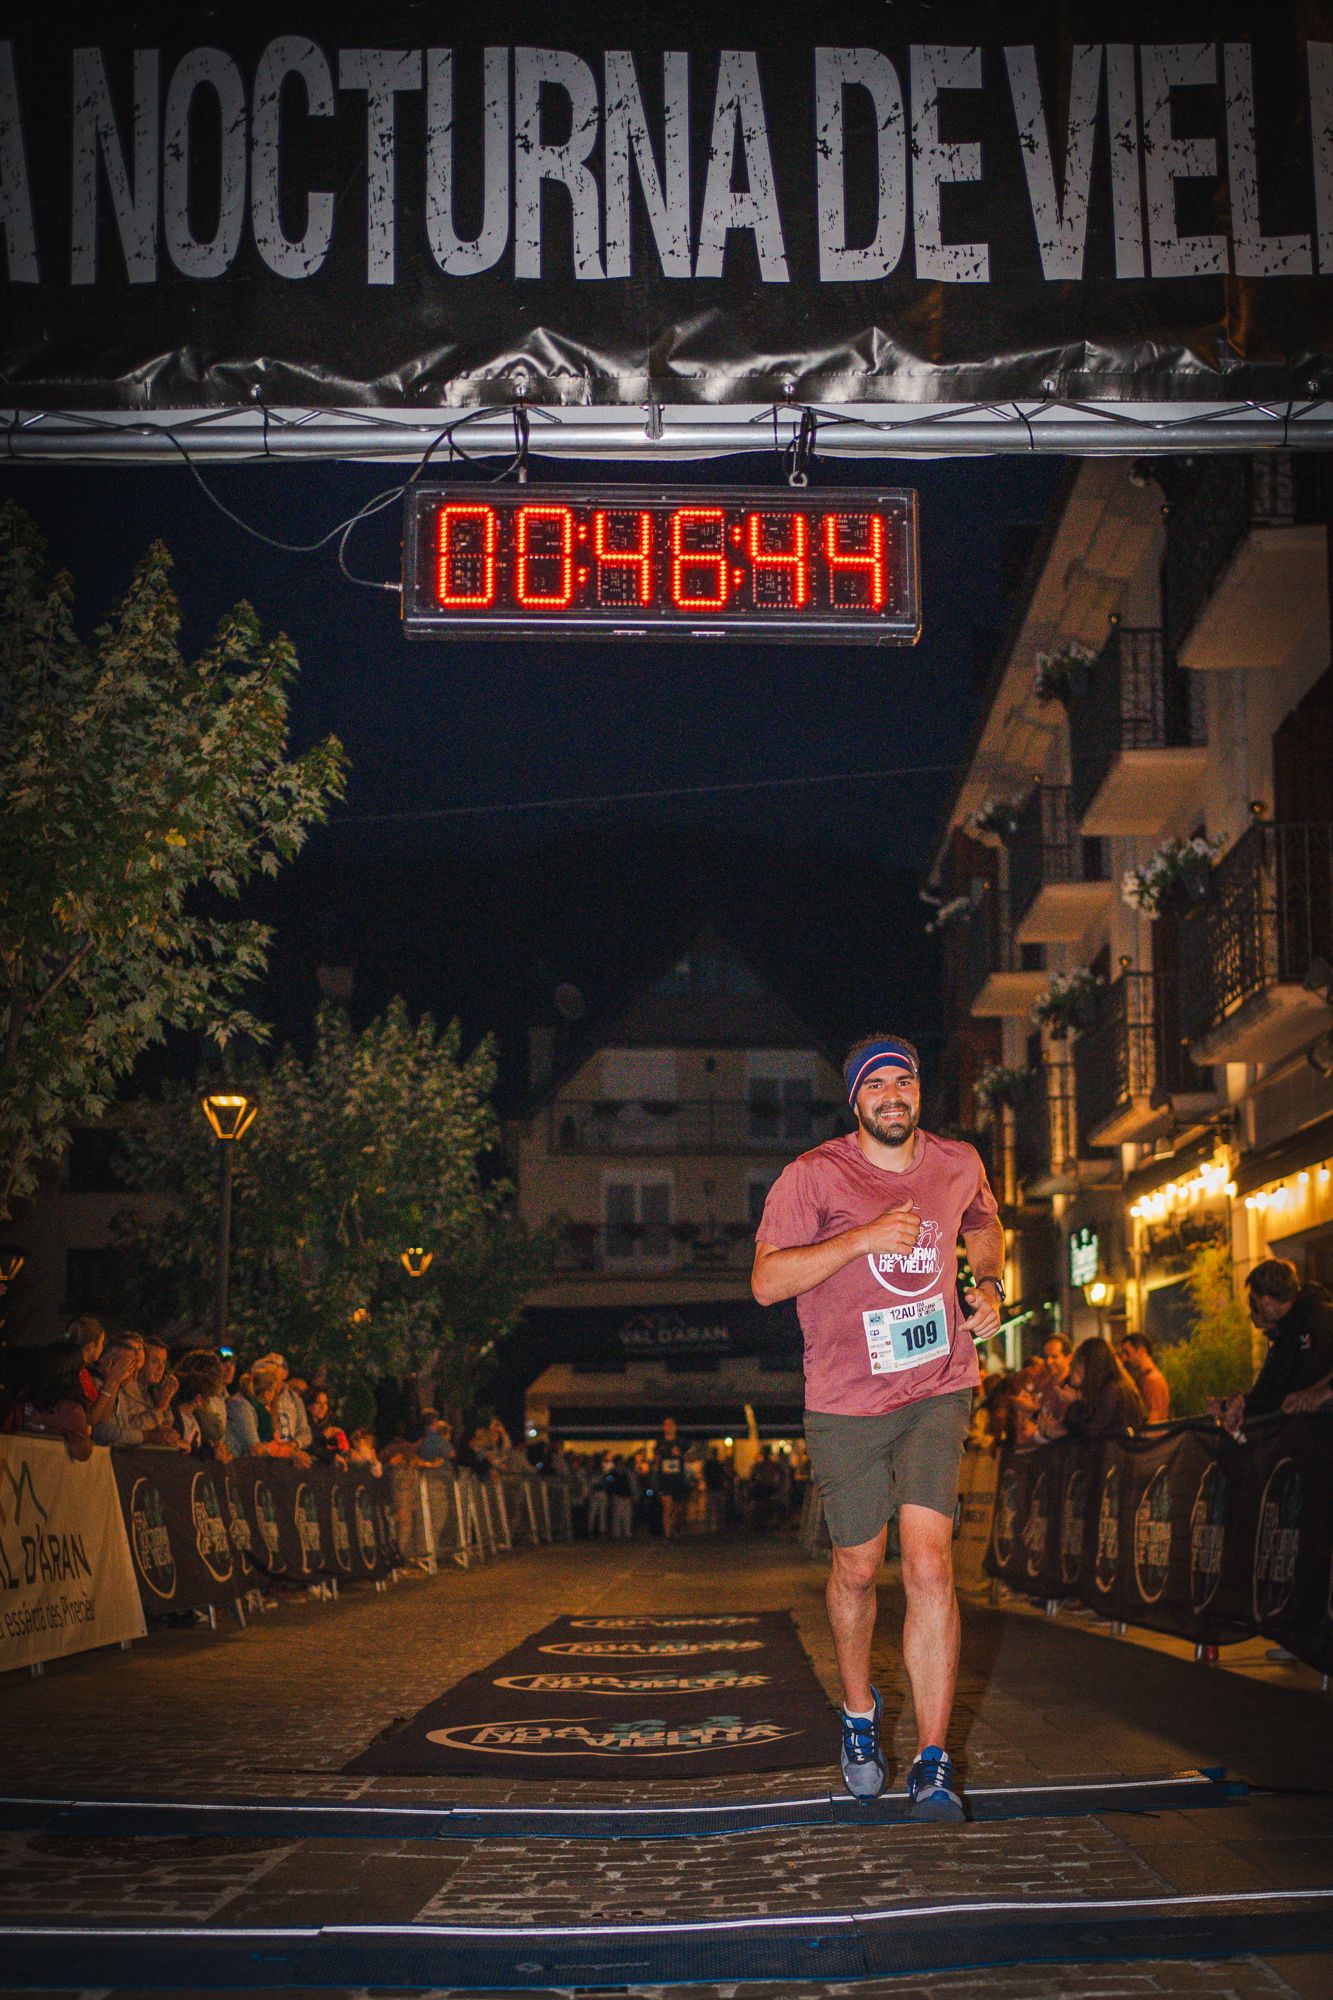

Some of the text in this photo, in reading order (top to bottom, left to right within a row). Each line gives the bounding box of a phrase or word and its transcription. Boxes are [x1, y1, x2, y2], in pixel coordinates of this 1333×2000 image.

[71, 35, 791, 286] NOCTURNA
[814, 44, 991, 283] DE
[439, 504, 884, 611] 00:46:44
[878, 1260, 935, 1274] DE VIELHA
[901, 1319, 938, 1352] 109
[21, 1524, 93, 1585] D'ARAN
